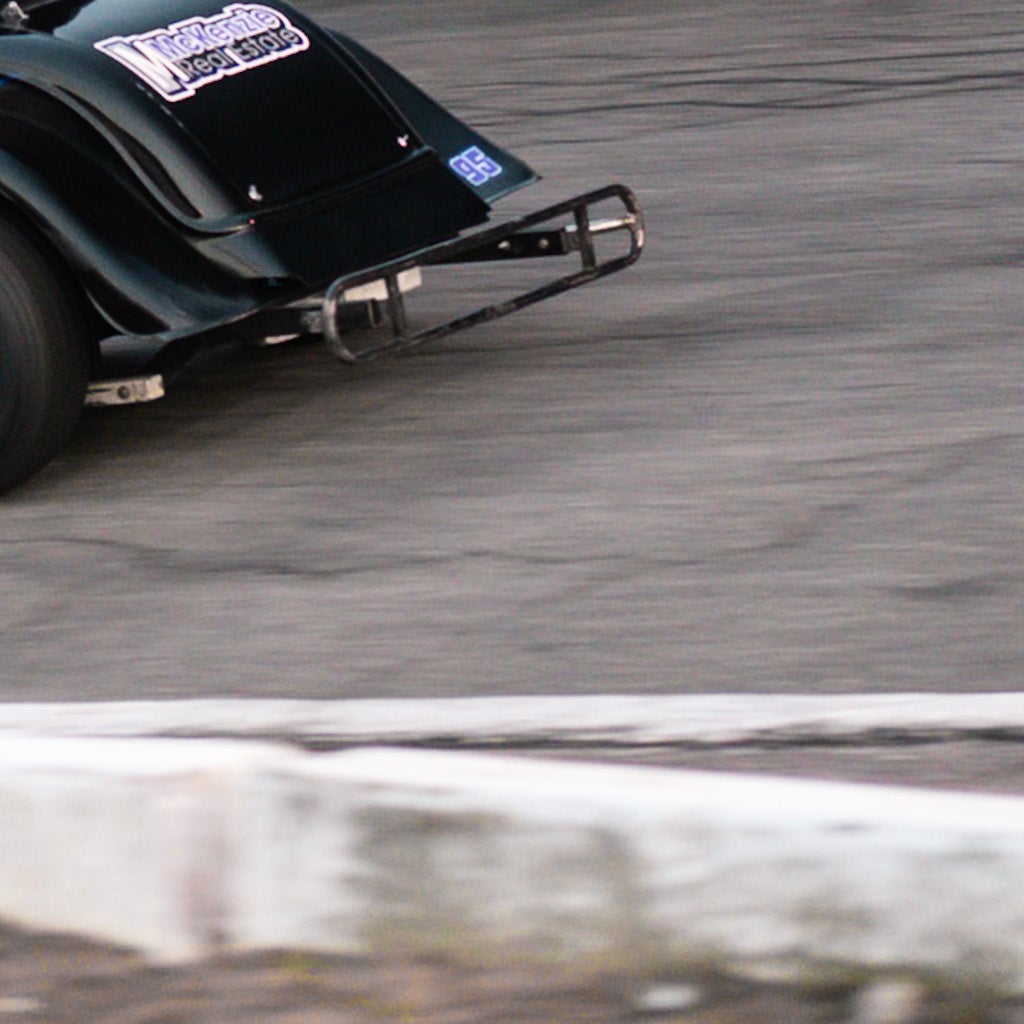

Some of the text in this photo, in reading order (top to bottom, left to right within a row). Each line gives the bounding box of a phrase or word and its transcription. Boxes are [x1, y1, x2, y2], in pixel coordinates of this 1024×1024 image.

[148, 8, 280, 60] McKenzie
[177, 27, 301, 78] Real Estate
[448, 145, 502, 187] 95
